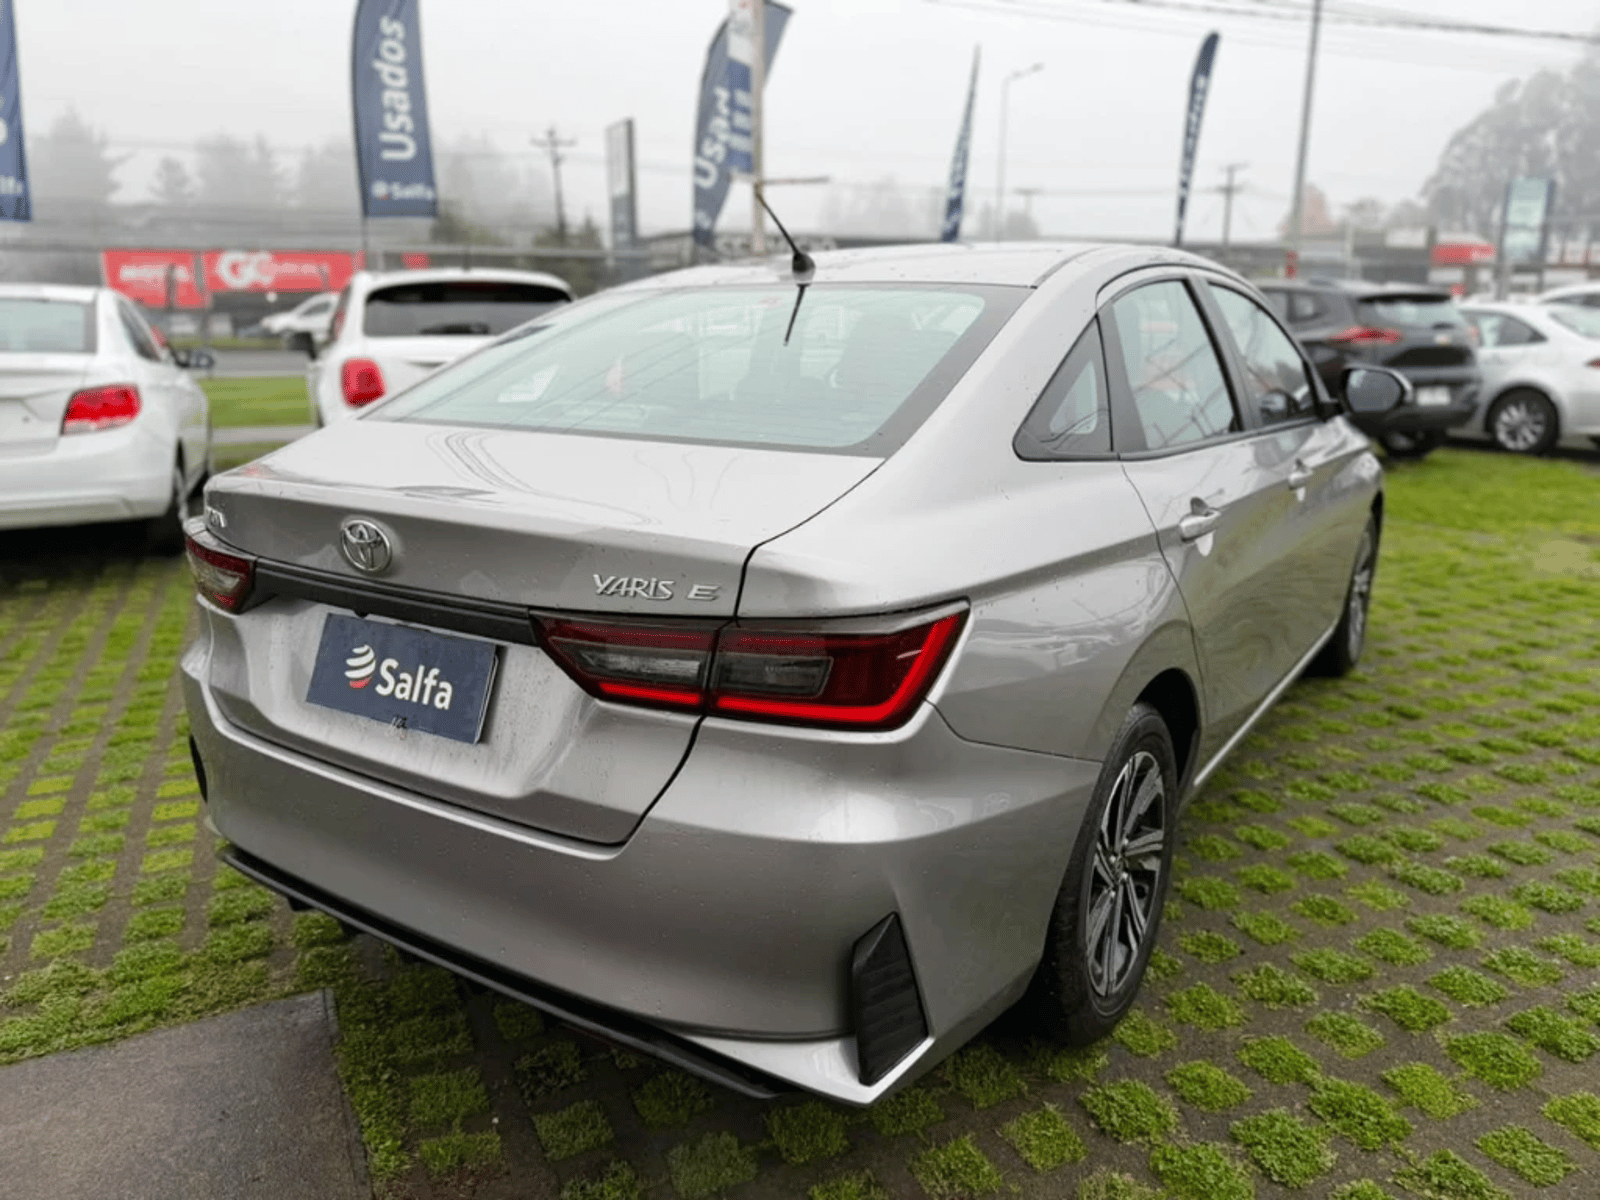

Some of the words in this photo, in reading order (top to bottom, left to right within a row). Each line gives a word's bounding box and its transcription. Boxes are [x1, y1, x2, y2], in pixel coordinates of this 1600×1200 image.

[372, 15, 418, 162] Usados
[593, 574, 676, 600] YARIS
[687, 584, 720, 601] E
[375, 658, 453, 710] Salfa
